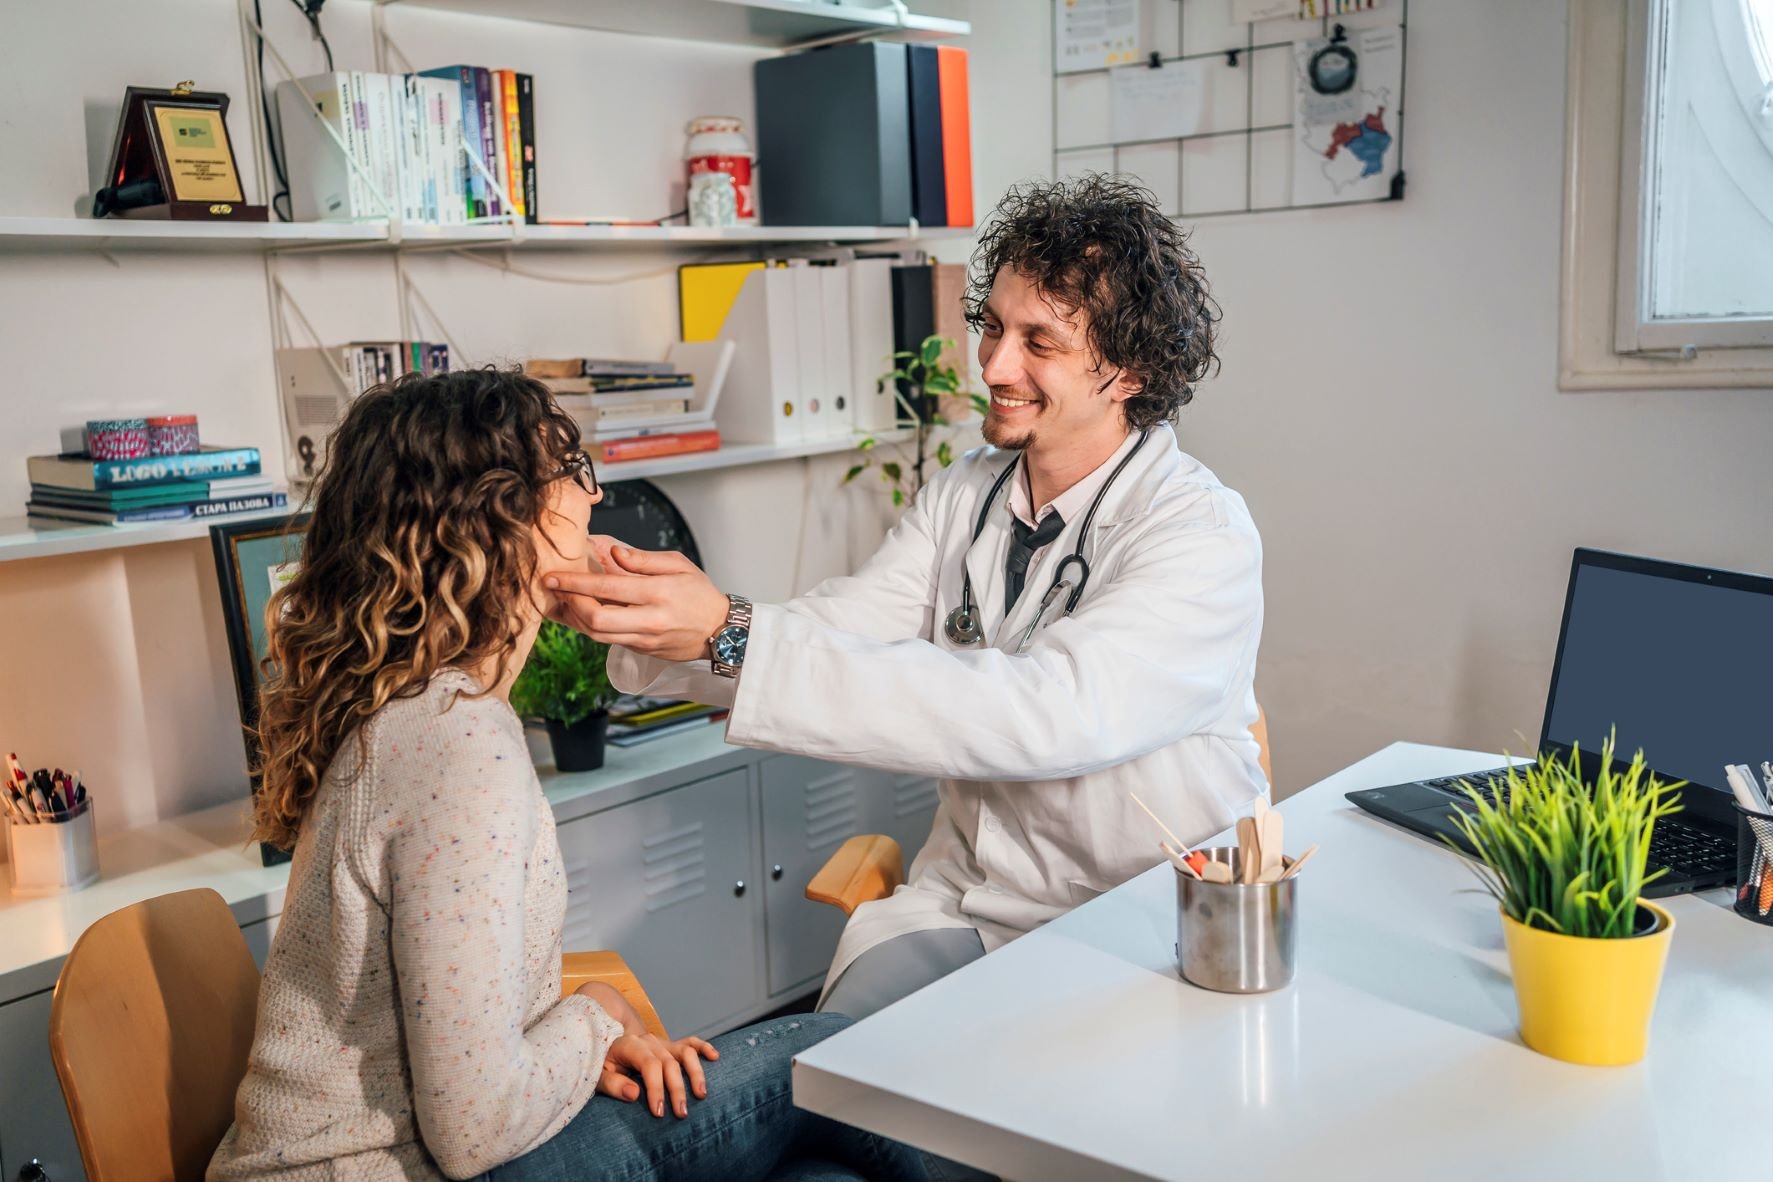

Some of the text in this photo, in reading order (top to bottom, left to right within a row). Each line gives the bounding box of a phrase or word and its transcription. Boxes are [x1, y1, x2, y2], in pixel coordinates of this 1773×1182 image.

[111, 464, 167, 482] LOGO
[195, 502, 228, 516] СТАРА
[229, 497, 270, 511] ПАЗОВА
[658, 530, 668, 548] 2
